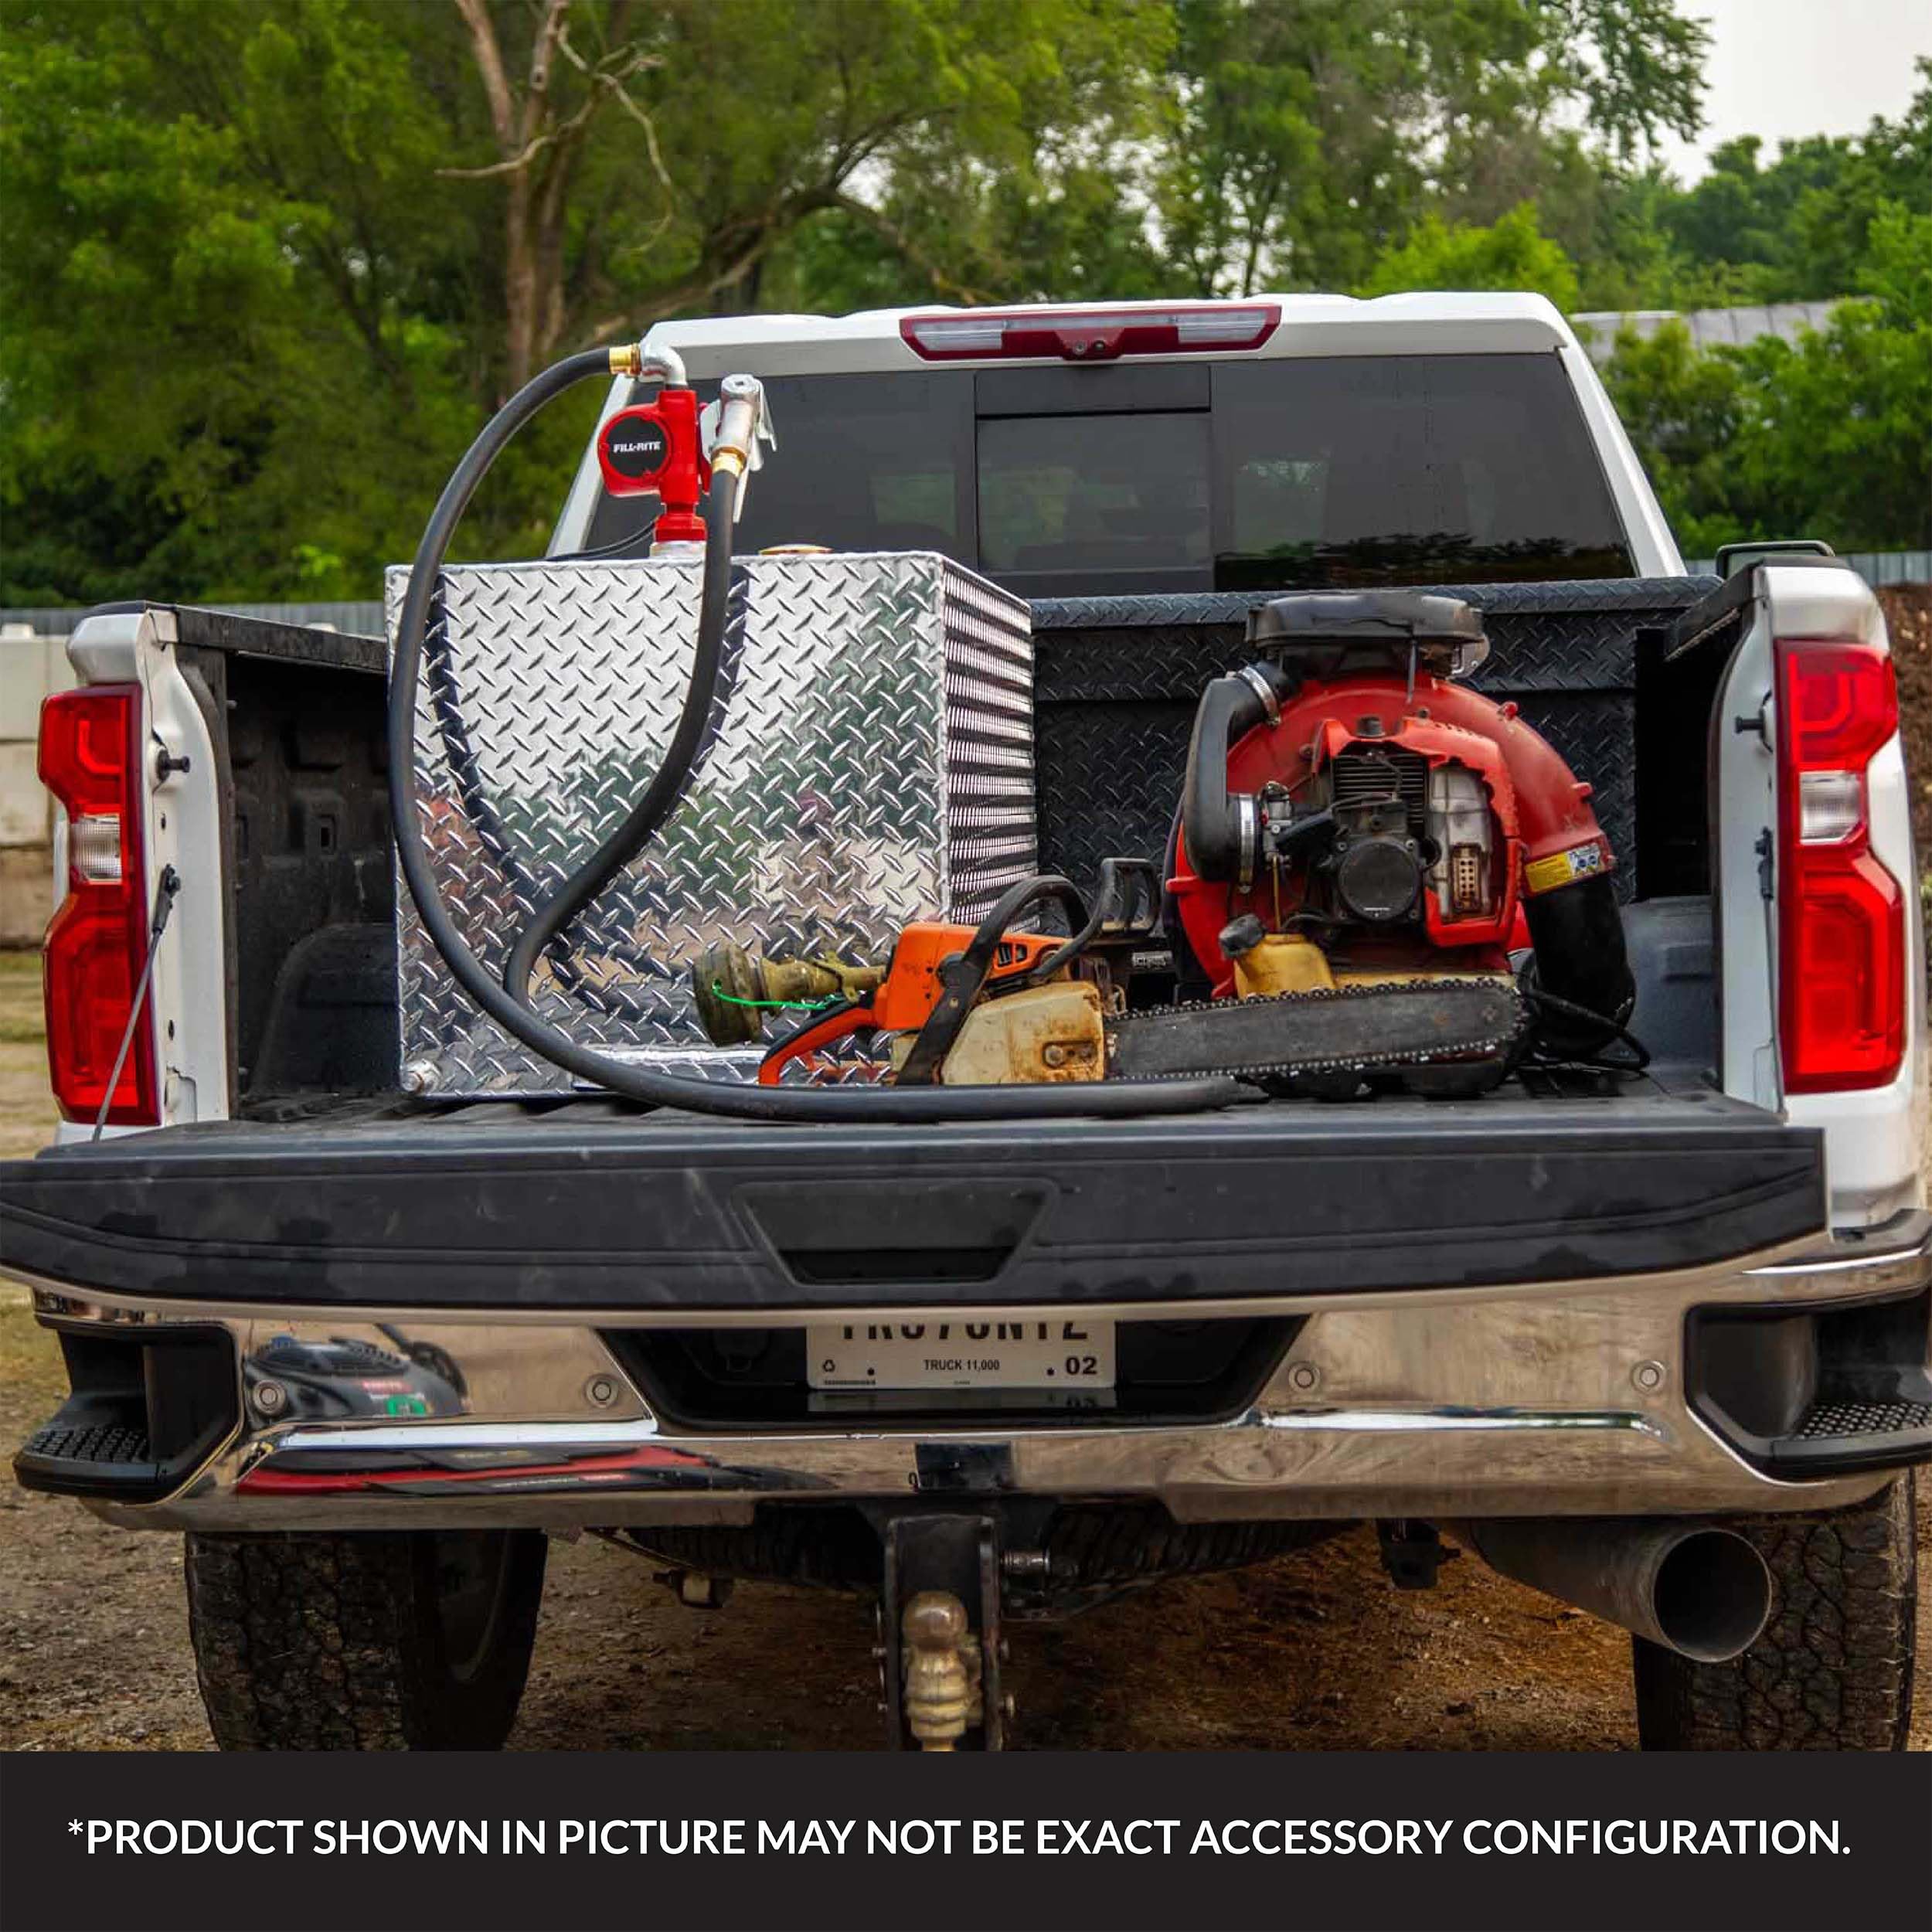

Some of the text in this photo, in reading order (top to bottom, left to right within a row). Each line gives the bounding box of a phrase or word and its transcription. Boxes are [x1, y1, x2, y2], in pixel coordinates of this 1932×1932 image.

[613, 441, 662, 454] FILL-RITE
[923, 1359, 1001, 1373] TRUCK 11,000
[1065, 1355, 1098, 1376] 02
